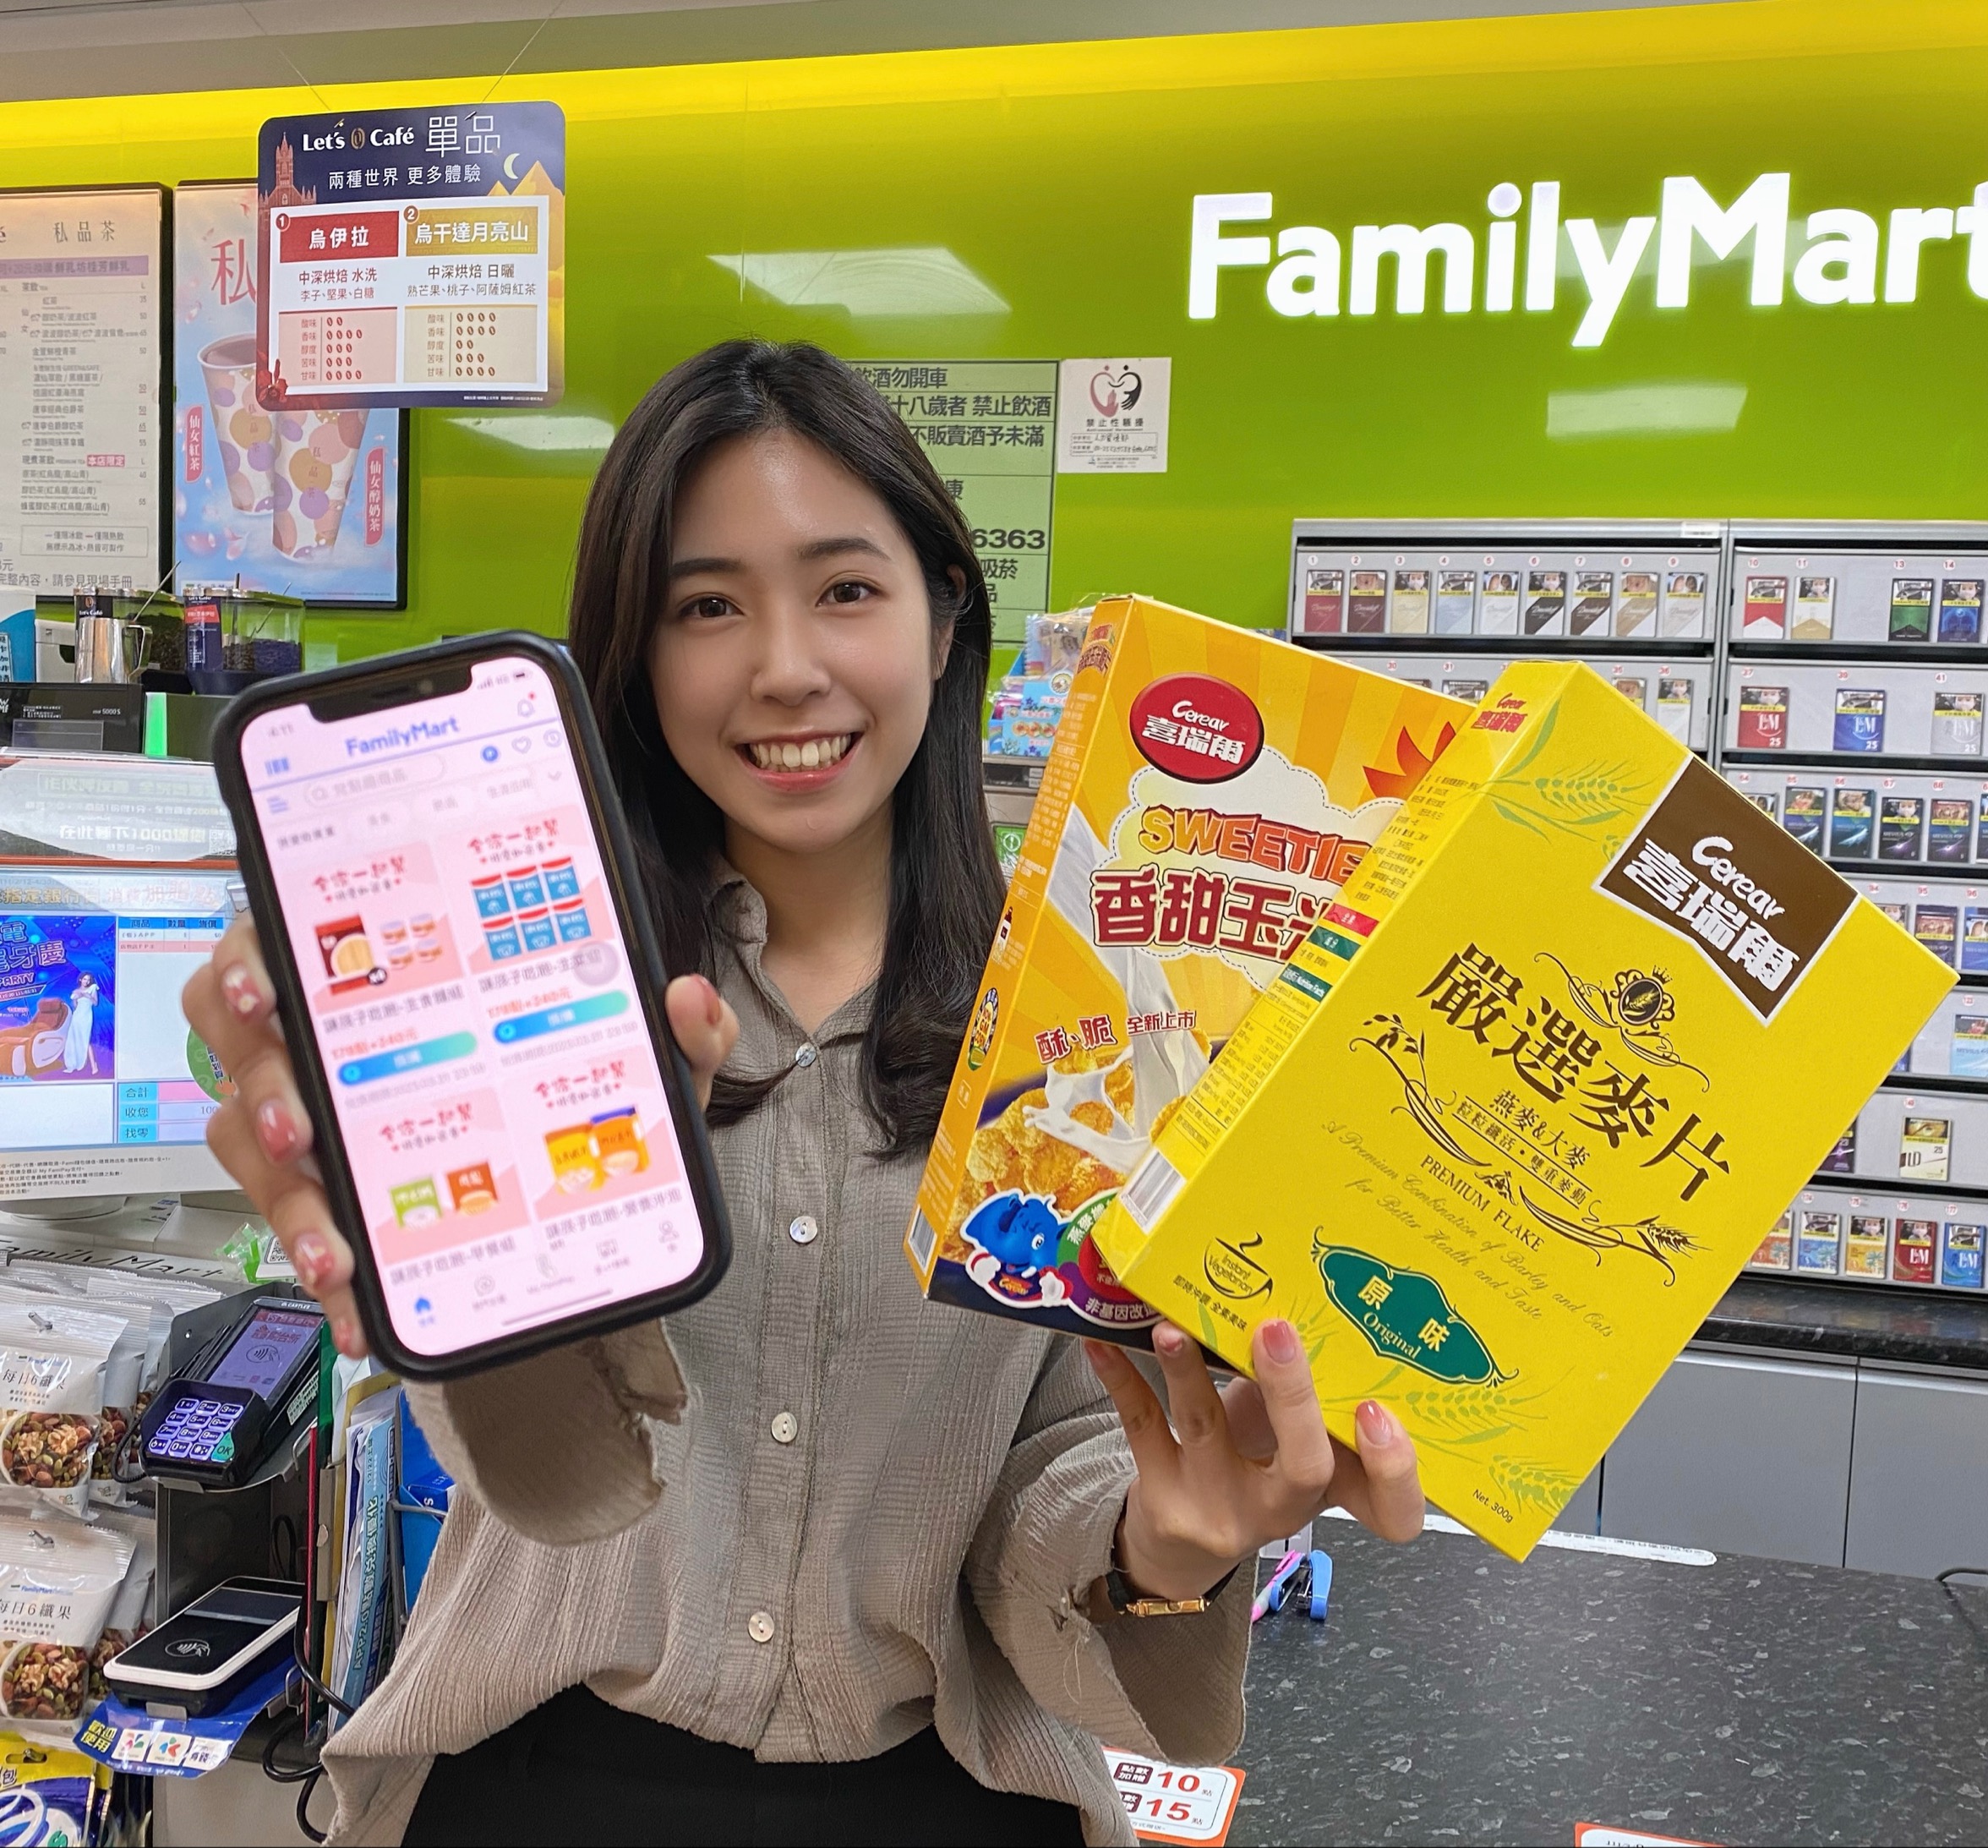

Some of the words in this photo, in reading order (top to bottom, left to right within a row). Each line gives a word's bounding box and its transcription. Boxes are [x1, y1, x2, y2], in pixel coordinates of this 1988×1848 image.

[303, 132, 345, 152] Let's
[370, 126, 414, 148] Café
[425, 115, 500, 157] 單品
[329, 167, 398, 190] 兩種世界
[407, 164, 481, 185] 更多體驗
[53, 220, 115, 243] 私品茶
[309, 227, 369, 249] 烏伊拉
[415, 221, 529, 244] 烏干達月亮山
[428, 265, 482, 280] 中深烘焙
[488, 264, 515, 279] 日曬
[1188, 172, 1988, 347] FamilyMart
[298, 270, 349, 285] 中深烘焙
[352, 268, 377, 282] 水洗
[885, 396, 967, 417] 十八歲者
[973, 395, 1051, 418] 禁止飲酒
[188, 415, 201, 471] 仙女紅茶
[912, 425, 1045, 447] 不販賣酒予未滿
[369, 460, 381, 533] 仙女醇奶茶
[345, 717, 460, 757] FamilyMart
[1142, 714, 1247, 765] 喜瑞爾
[1139, 805, 1371, 887] SWEETIE
[1622, 838, 1800, 992] 喜瑞爾
[0, 921, 26, 943] 電
[1128, 1009, 1198, 1036] 全新上市
[1035, 1014, 1116, 1065] 酥、脆
[1416, 942, 1730, 1202] 嚴選麥片
[126, 1087, 149, 1099] 合計
[125, 1107, 149, 1118] 收您
[125, 1128, 149, 1139] 找零
[1489, 1087, 1591, 1172] 燕麥&大麥
[1420, 1154, 1491, 1212] PREMIUM
[1493, 1209, 1544, 1253] FLAKE
[1339, 1124, 1399, 1181] Premium
[1402, 1173, 1477, 1240] Combination
[1481, 1236, 1498, 1259] of
[1500, 1249, 1549, 1291] Barley
[1552, 1289, 1581, 1315] and
[1583, 1309, 1615, 1338] Oats
[1344, 1173, 1374, 1196] for
[1376, 1195, 1422, 1230] Better
[1424, 1227, 1472, 1268] Health
[1474, 1269, 1502, 1293] and
[1505, 1285, 1543, 1321] Taste
[1220, 1252, 1253, 1282] Instant
[1363, 1311, 1422, 1360] Original
[216, 1444, 232, 1454] OK
[1472, 1488, 1493, 1509] Net.
[1491, 1501, 1515, 1524] 300g
[80, 1731, 112, 1753] 使用
[89, 1720, 117, 1741] 歡迎
[1157, 1771, 1200, 1792] 10
[1146, 1799, 1192, 1821] 15
